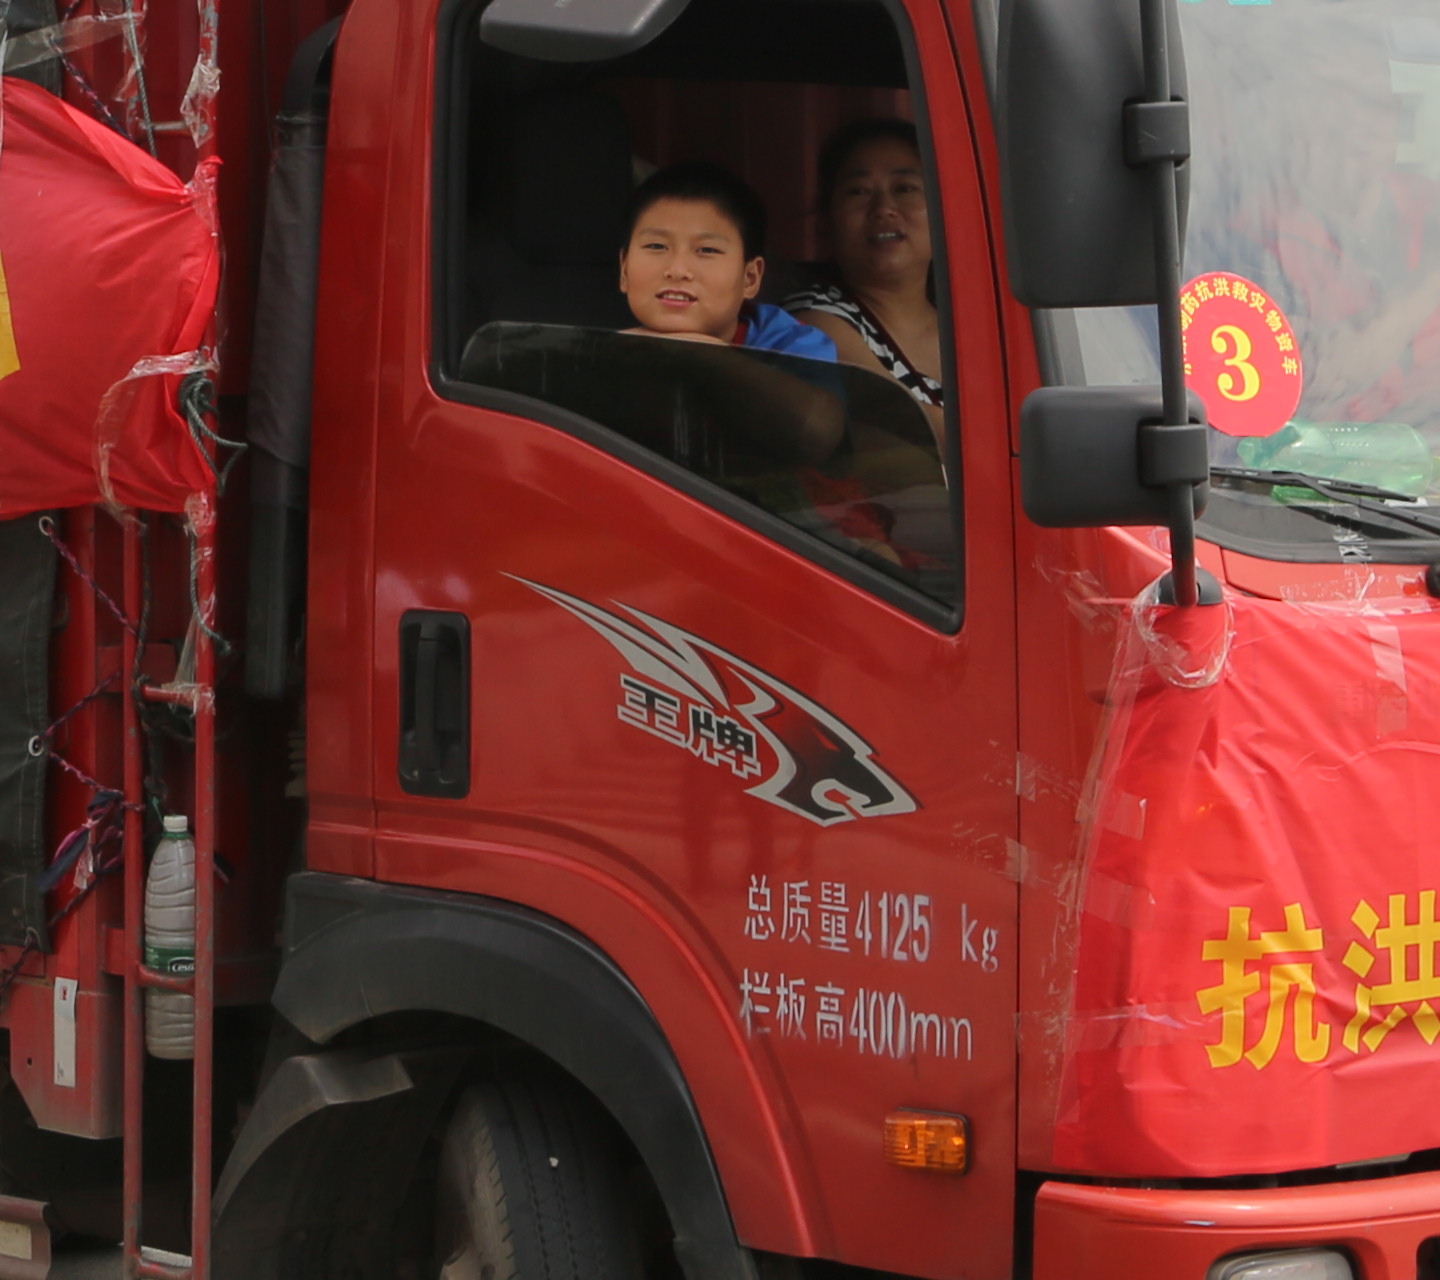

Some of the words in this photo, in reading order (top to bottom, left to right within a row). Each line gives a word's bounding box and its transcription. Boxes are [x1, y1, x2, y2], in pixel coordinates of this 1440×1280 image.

[1211, 324, 1261, 402] 3
[617, 673, 762, 780] 王牌
[744, 874, 931, 962] 总质量4125
[739, 968, 972, 1061] 栏板高400mm
